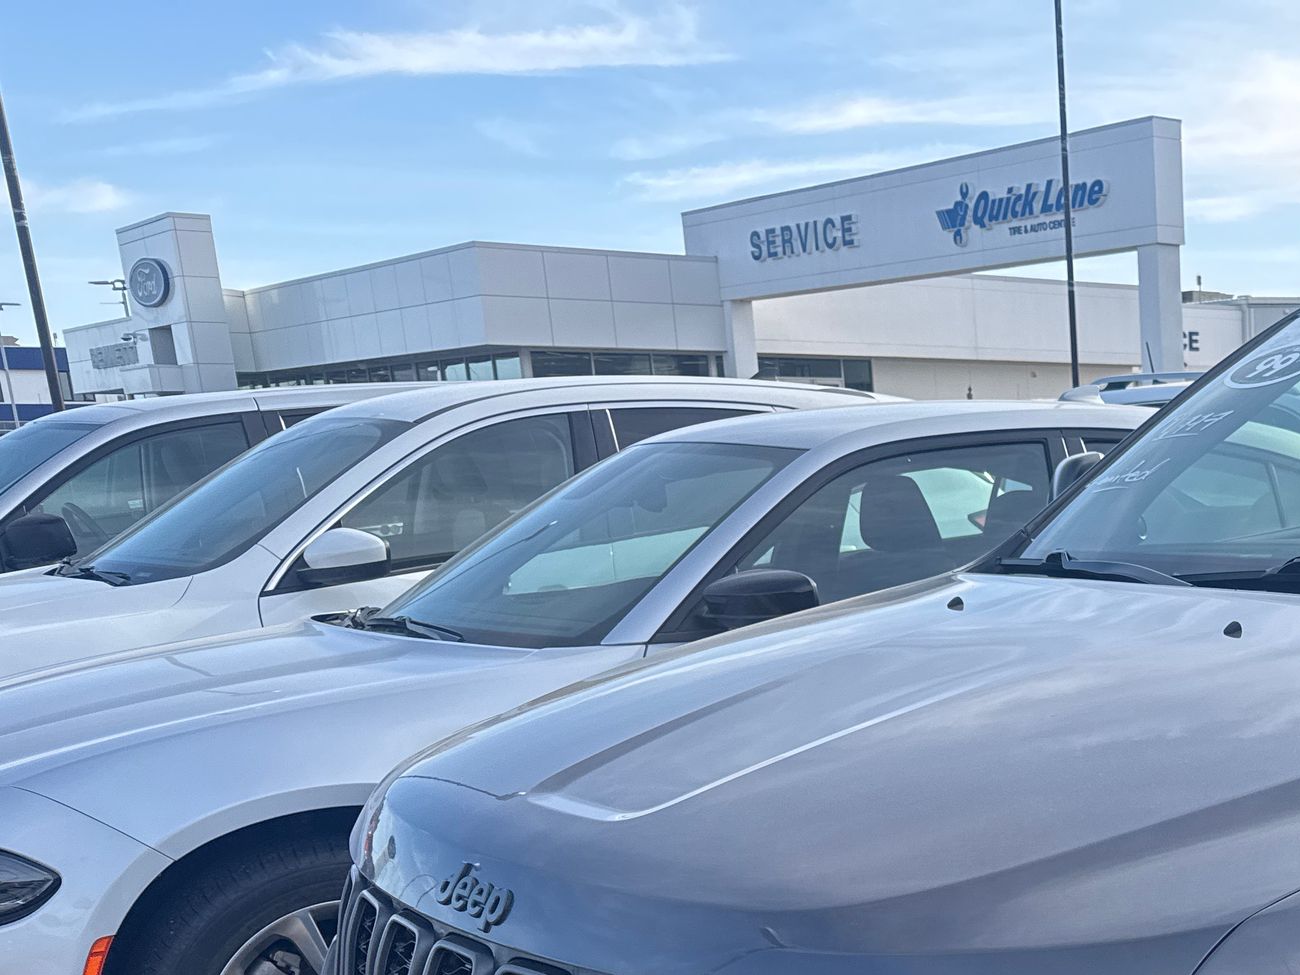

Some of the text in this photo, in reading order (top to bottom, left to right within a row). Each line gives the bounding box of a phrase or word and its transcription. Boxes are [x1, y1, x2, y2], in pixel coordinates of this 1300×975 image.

[973, 182, 1038, 228] Quick
[750, 213, 856, 261] SERVICE
[1008, 225, 1023, 236] TIRE
[1030, 222, 1048, 233] AUTO
[436, 861, 514, 933] Jeep
